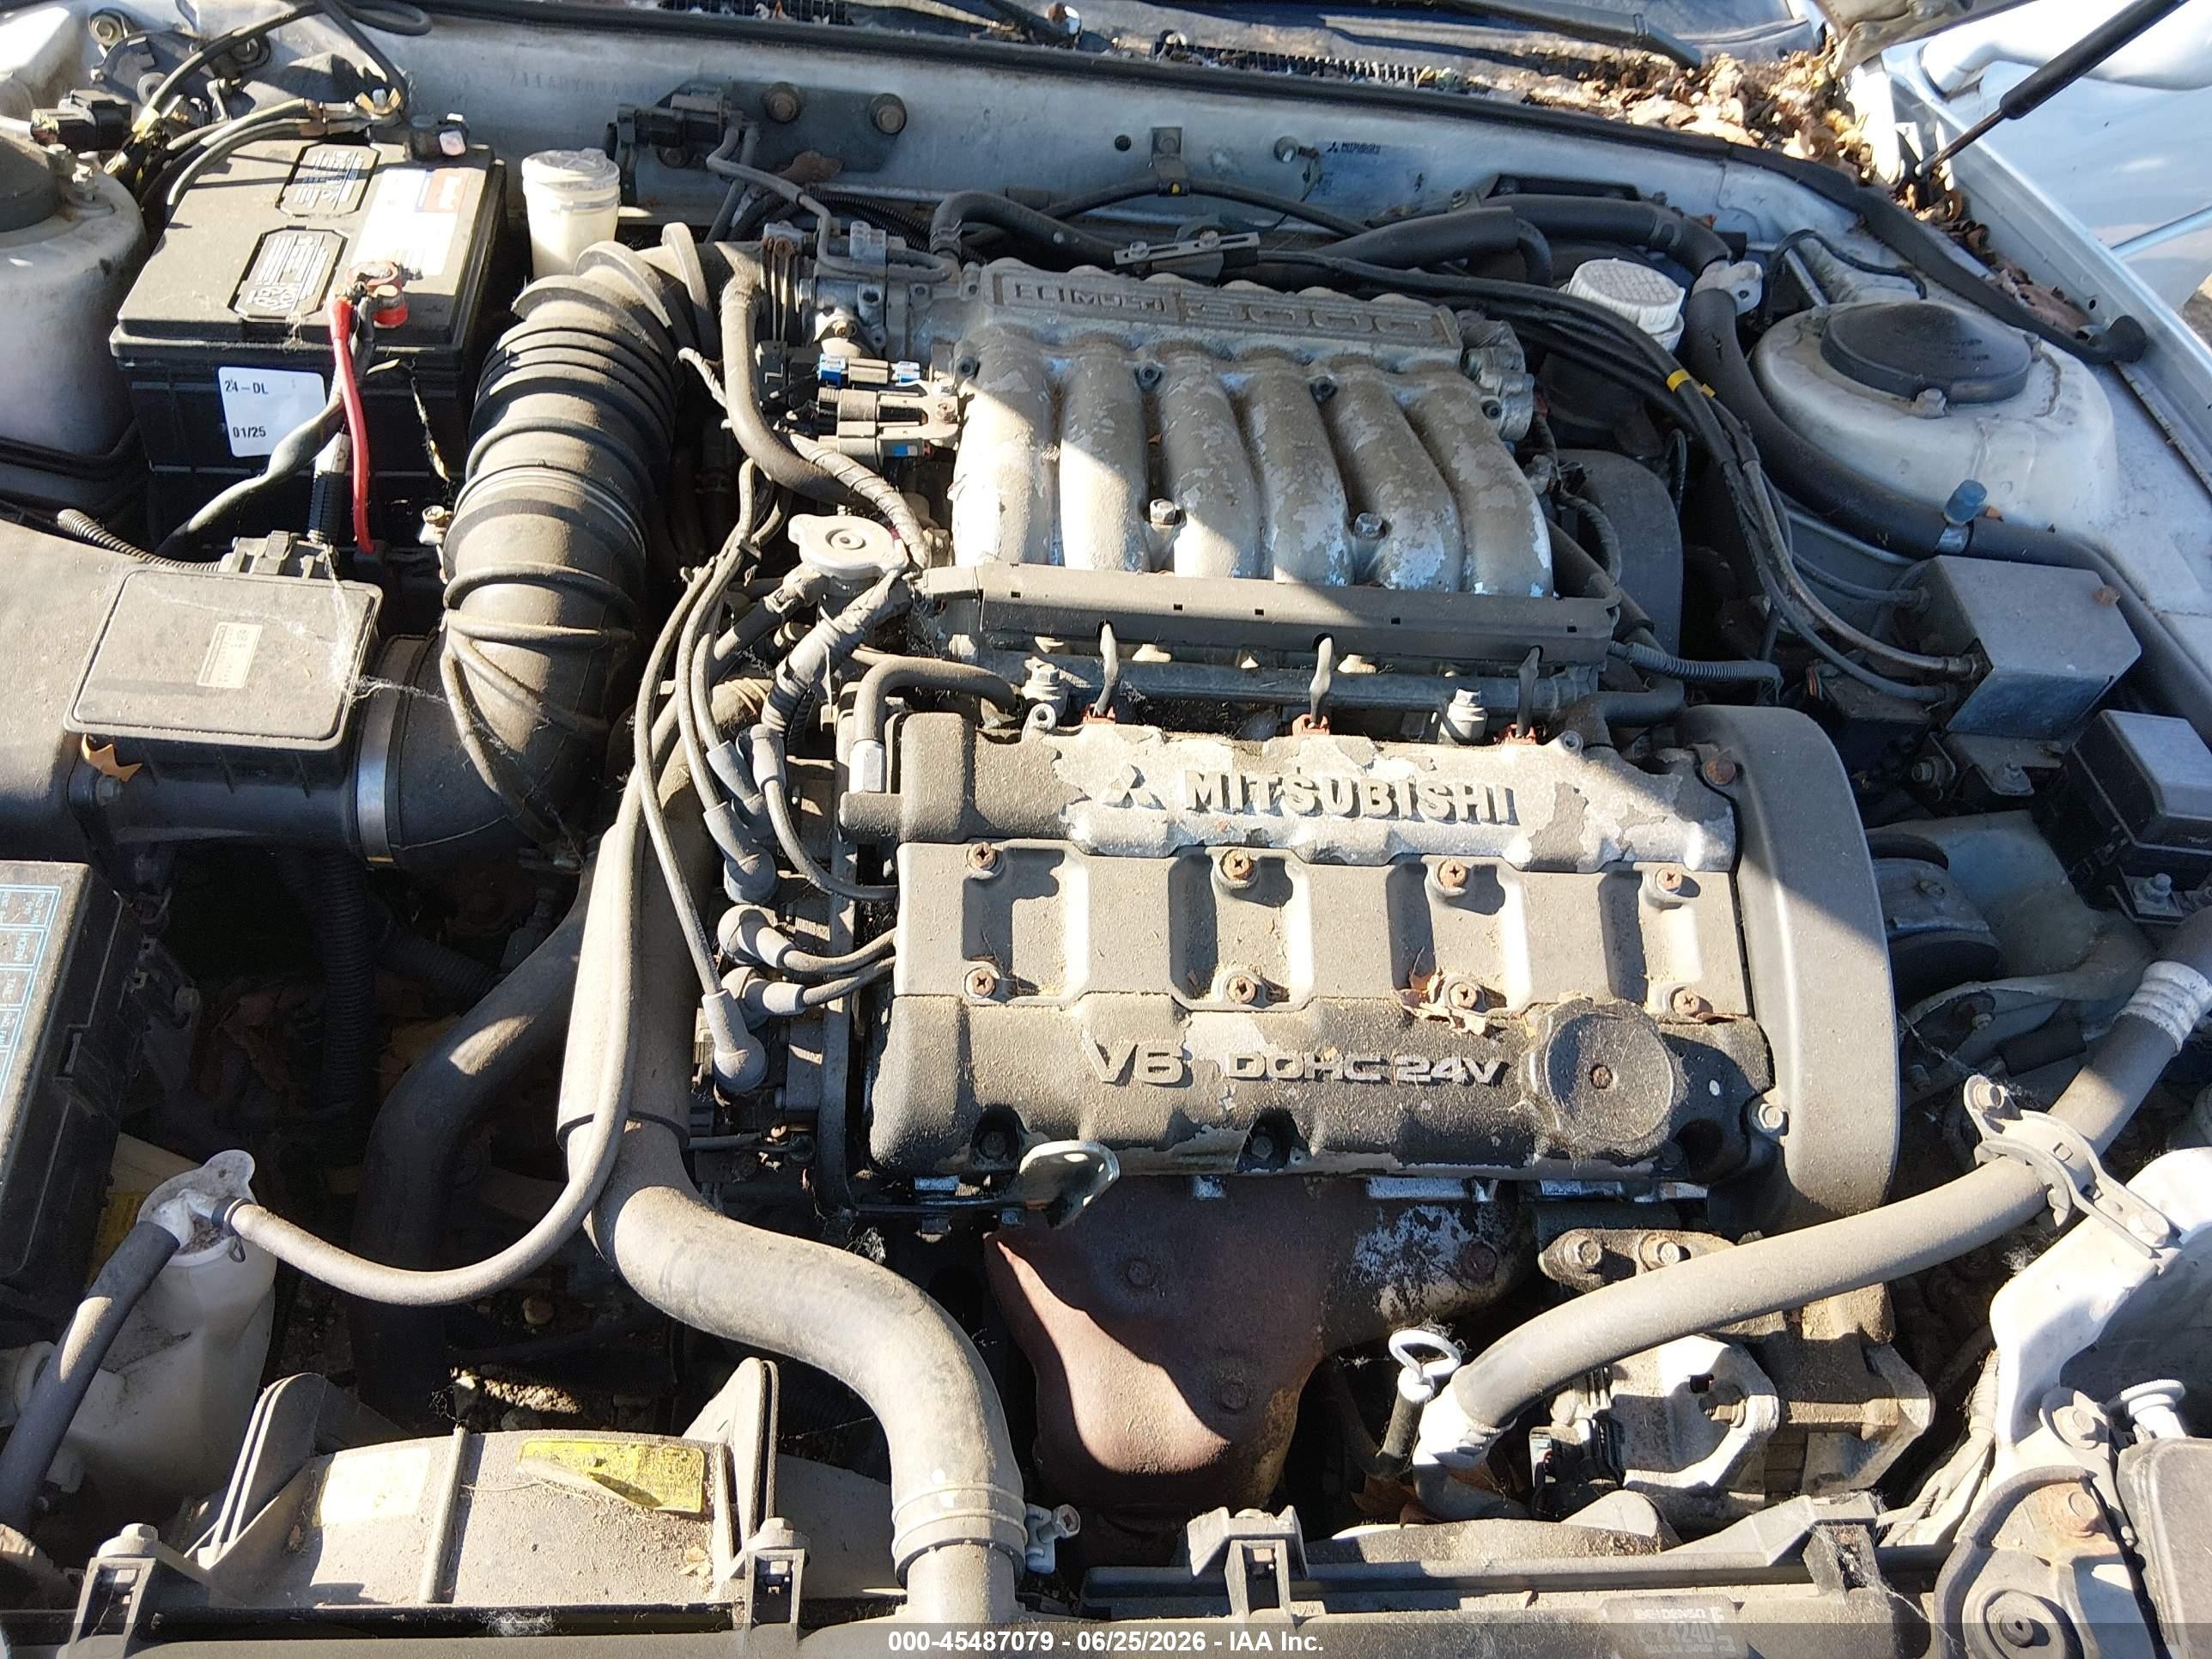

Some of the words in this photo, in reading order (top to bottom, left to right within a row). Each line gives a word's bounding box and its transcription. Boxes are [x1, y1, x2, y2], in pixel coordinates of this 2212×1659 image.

[224, 380, 239, 392] 24
[252, 381, 269, 395] DL
[232, 425, 267, 439] 01/25
[1185, 769, 1519, 825] MITSUBISHI
[13, 932, 29, 961] HORN
[1078, 1033, 1192, 1086] V6
[1228, 1050, 1381, 1082] DOHC
[1395, 1053, 1508, 1086] 24V
